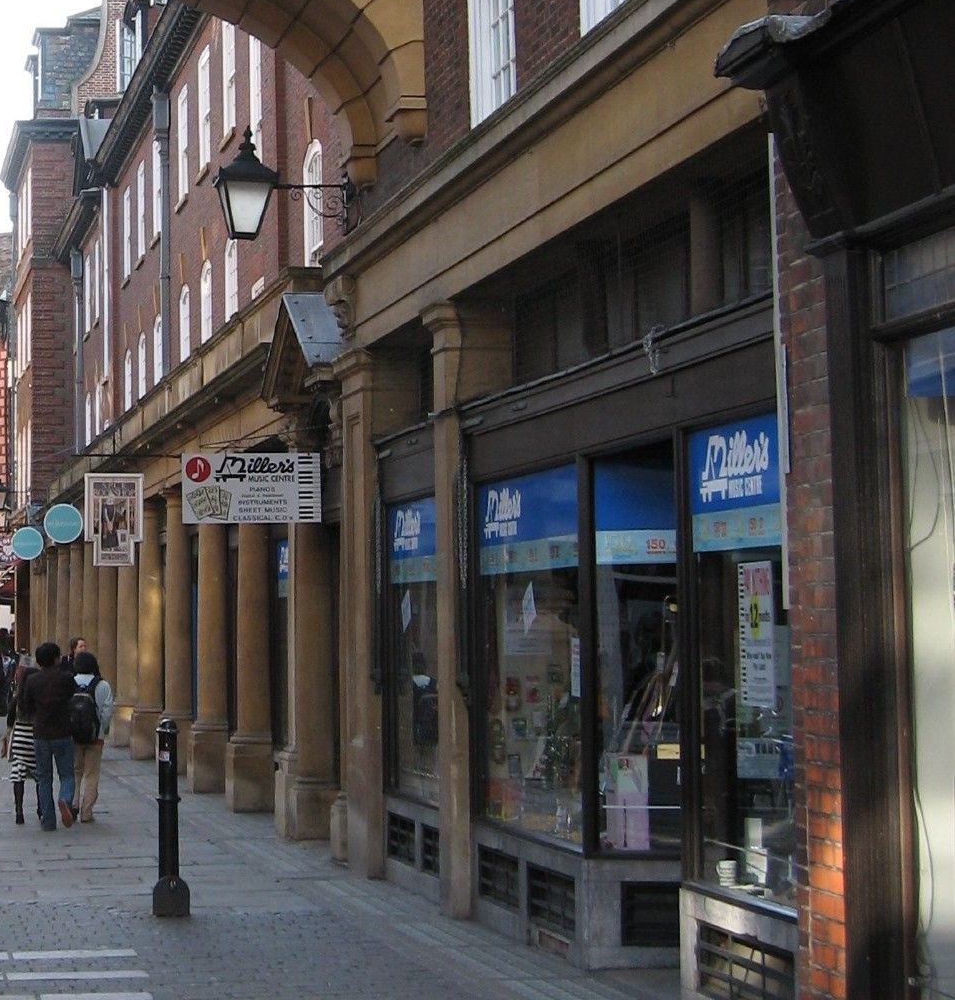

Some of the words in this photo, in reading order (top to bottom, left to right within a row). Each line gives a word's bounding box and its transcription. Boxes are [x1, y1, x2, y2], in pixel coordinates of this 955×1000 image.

[701, 430, 770, 481] Miller's
[214, 456, 295, 475] Miller's
[646, 538, 666, 550] 150
